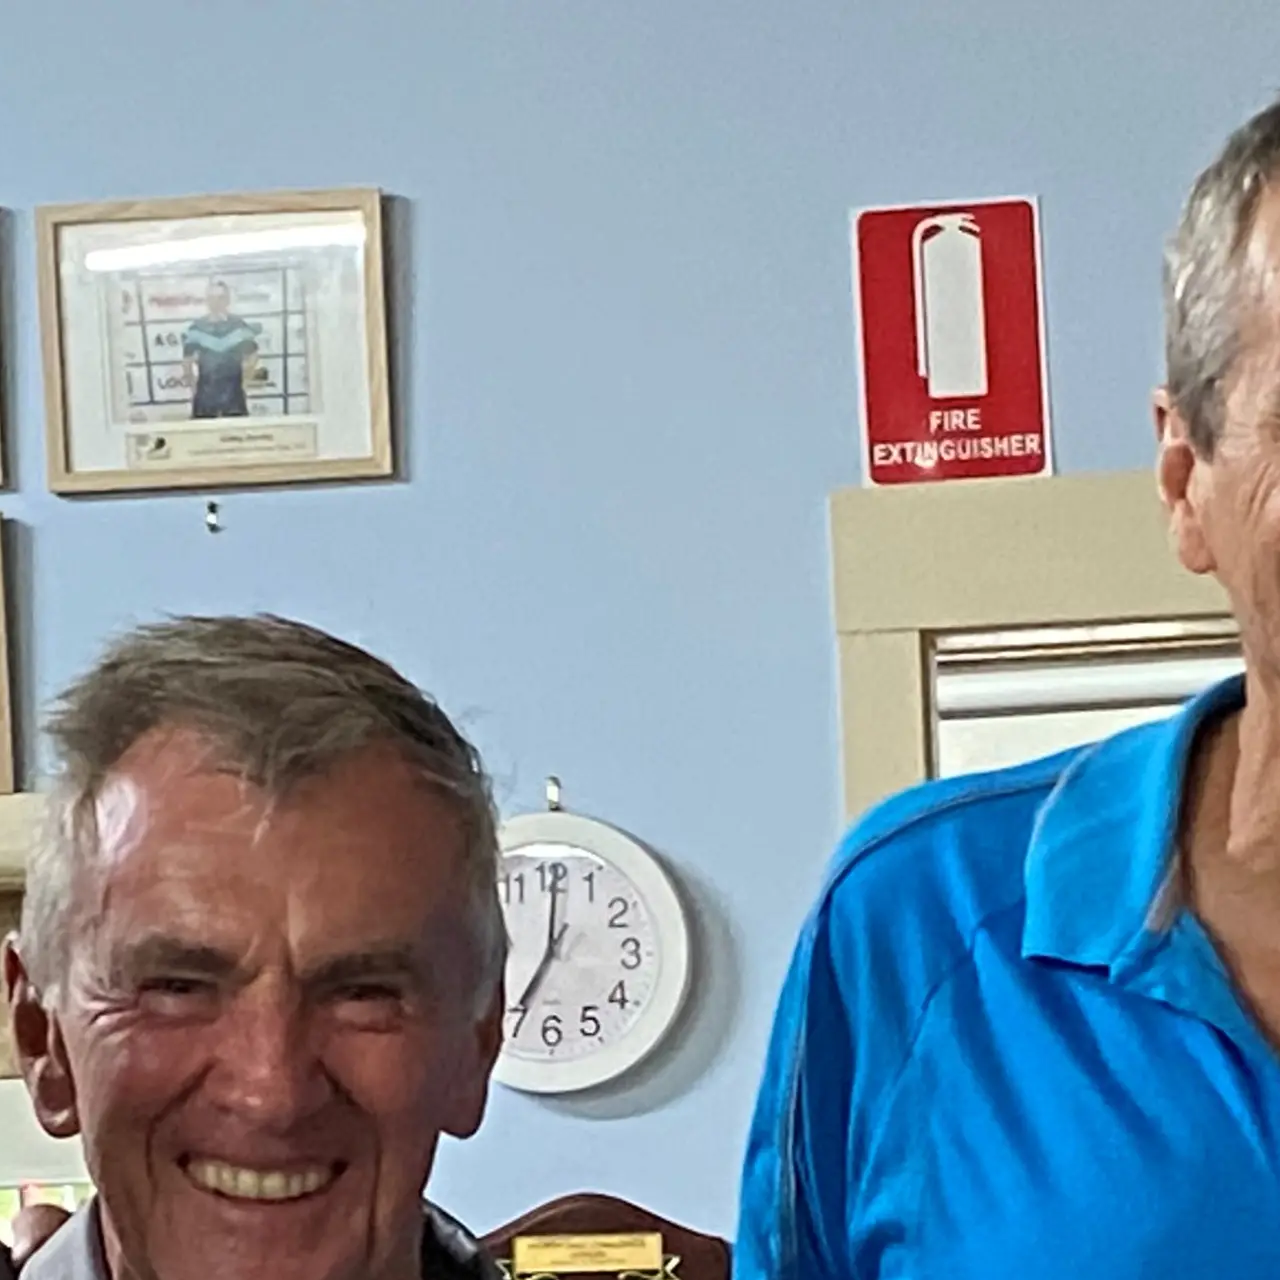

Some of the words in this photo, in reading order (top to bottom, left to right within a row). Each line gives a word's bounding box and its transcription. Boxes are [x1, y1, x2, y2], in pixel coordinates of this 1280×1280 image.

[929, 409, 982, 433] FIRE
[872, 433, 1042, 467] EXTINGUISHER
[504, 872, 525, 904] 11
[535, 862, 568, 893] 12
[582, 872, 595, 902] 1
[608, 897, 629, 929] 2
[621, 937, 642, 970] 3
[608, 979, 629, 1010] 4
[507, 1007, 529, 1038] 7
[541, 1014, 564, 1048] 6
[579, 1006, 601, 1038] 5
